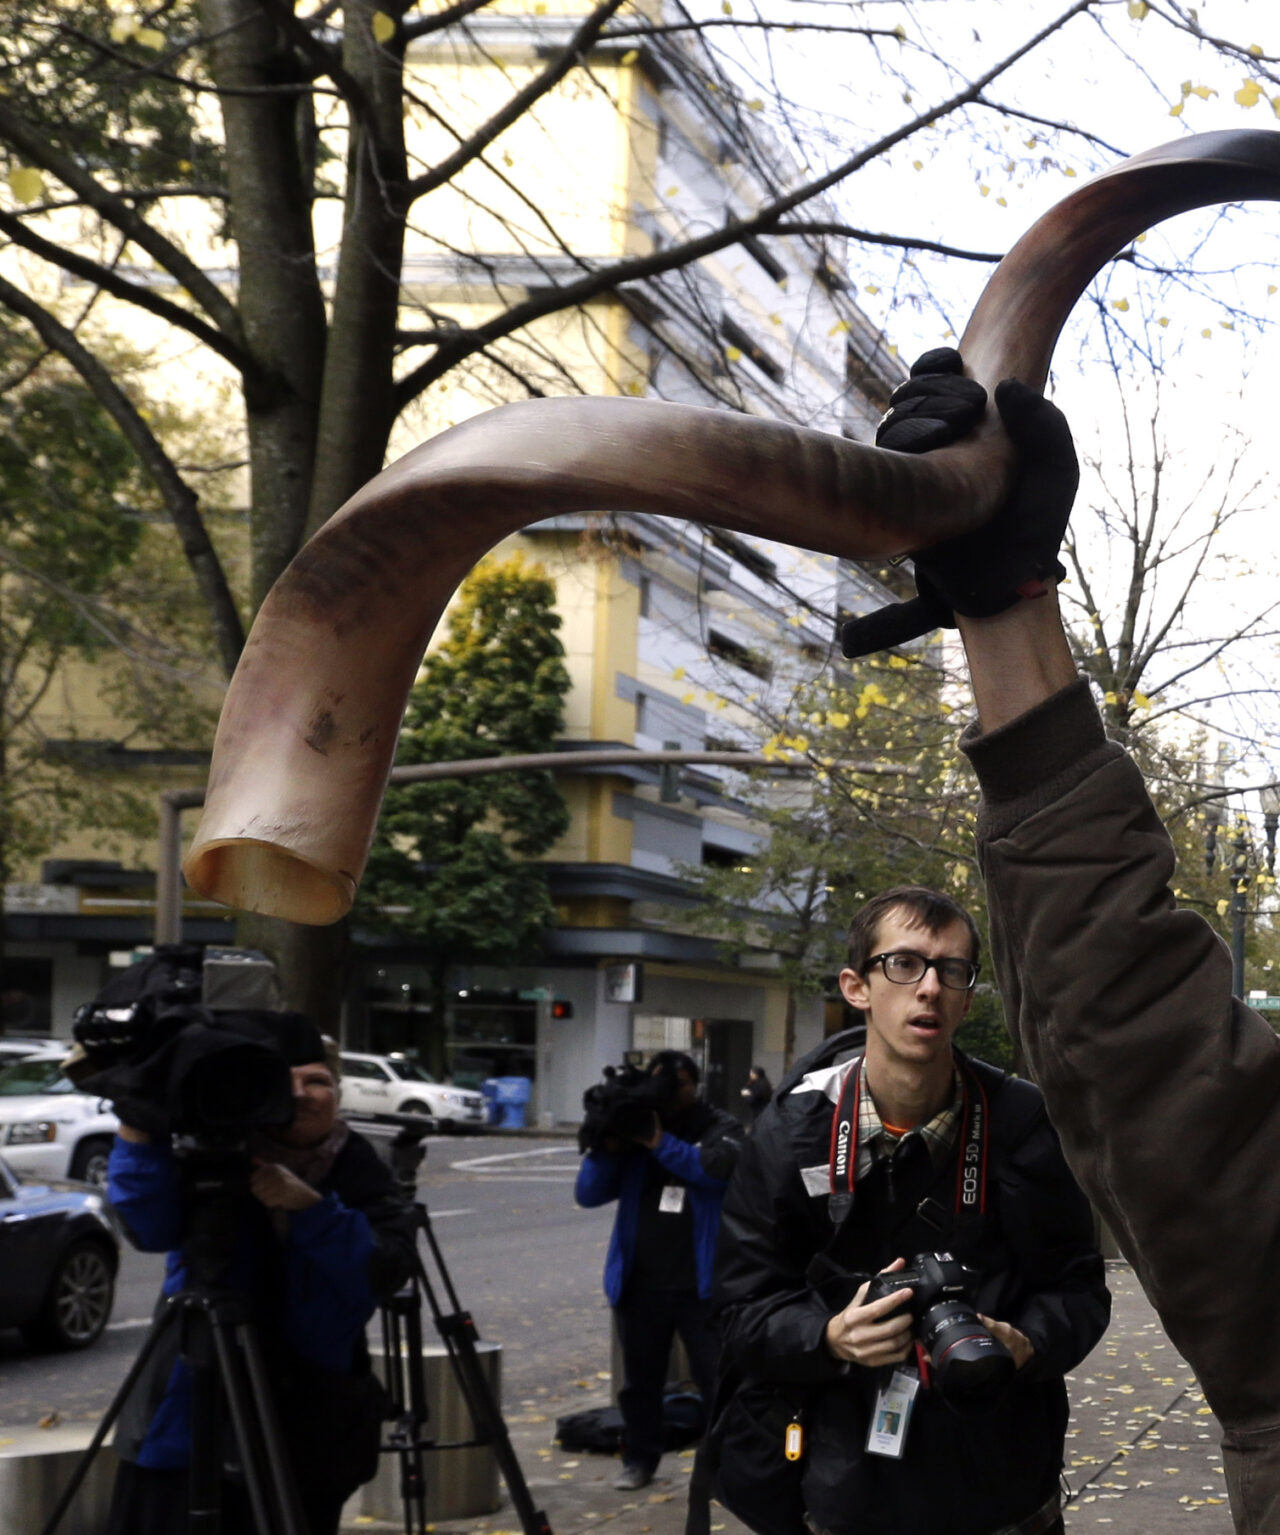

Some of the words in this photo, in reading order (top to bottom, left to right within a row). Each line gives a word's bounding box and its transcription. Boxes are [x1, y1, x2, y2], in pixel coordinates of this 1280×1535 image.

[972, 1114, 981, 1139] Mark
[836, 1120, 851, 1175] Canon
[966, 1143, 979, 1162] 5D
[962, 1167, 977, 1204] EOS
